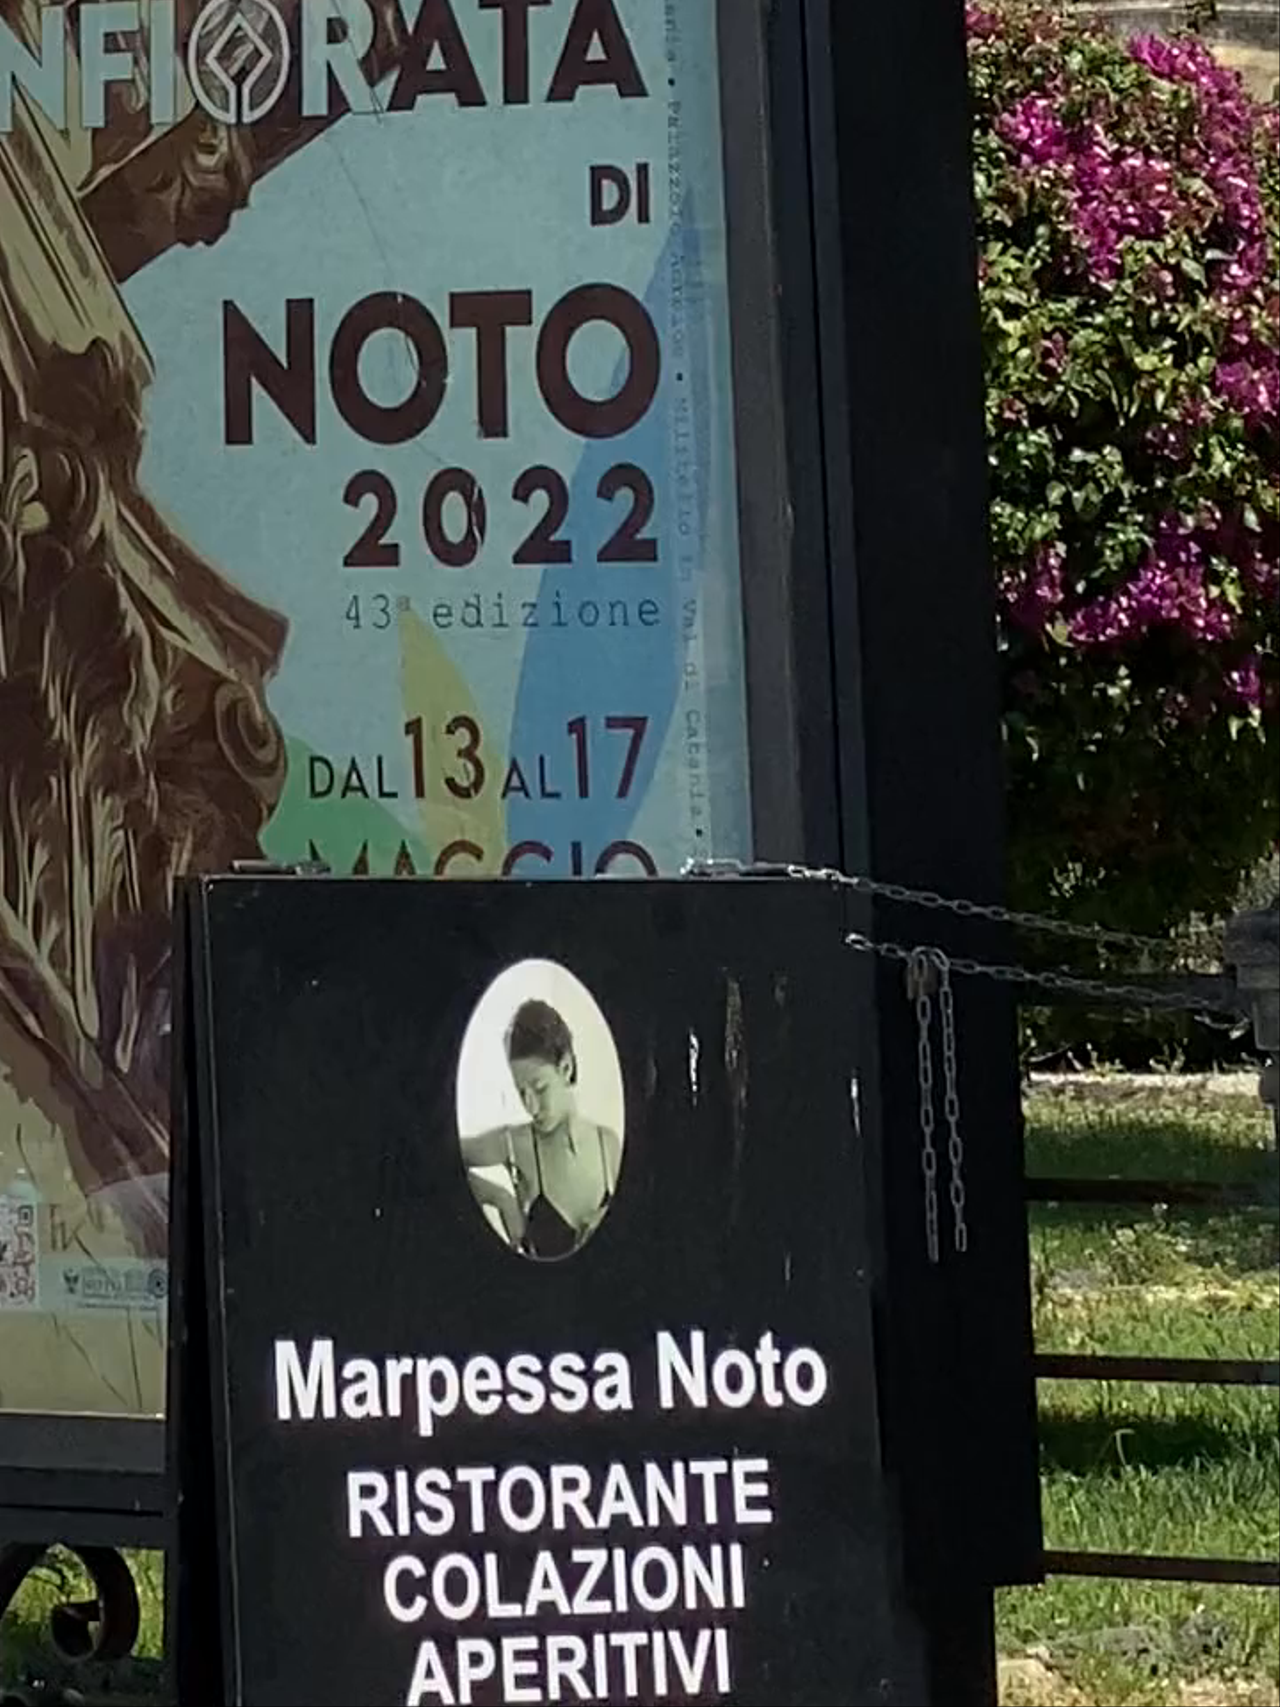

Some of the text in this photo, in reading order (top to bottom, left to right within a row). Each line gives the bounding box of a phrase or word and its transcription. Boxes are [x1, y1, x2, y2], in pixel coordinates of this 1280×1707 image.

[588, 162, 650, 226] DI
[223, 282, 661, 446] NOTO
[342, 463, 659, 568] 2022
[432, 589, 662, 630] edizione
[686, 709, 705, 818] Catania
[273, 1330, 828, 1437] Marpessa Noto
[346, 1457, 773, 1538] RISTORANTE
[383, 1542, 745, 1623] COLAZIONI
[406, 1628, 731, 1707] APERITIVI
